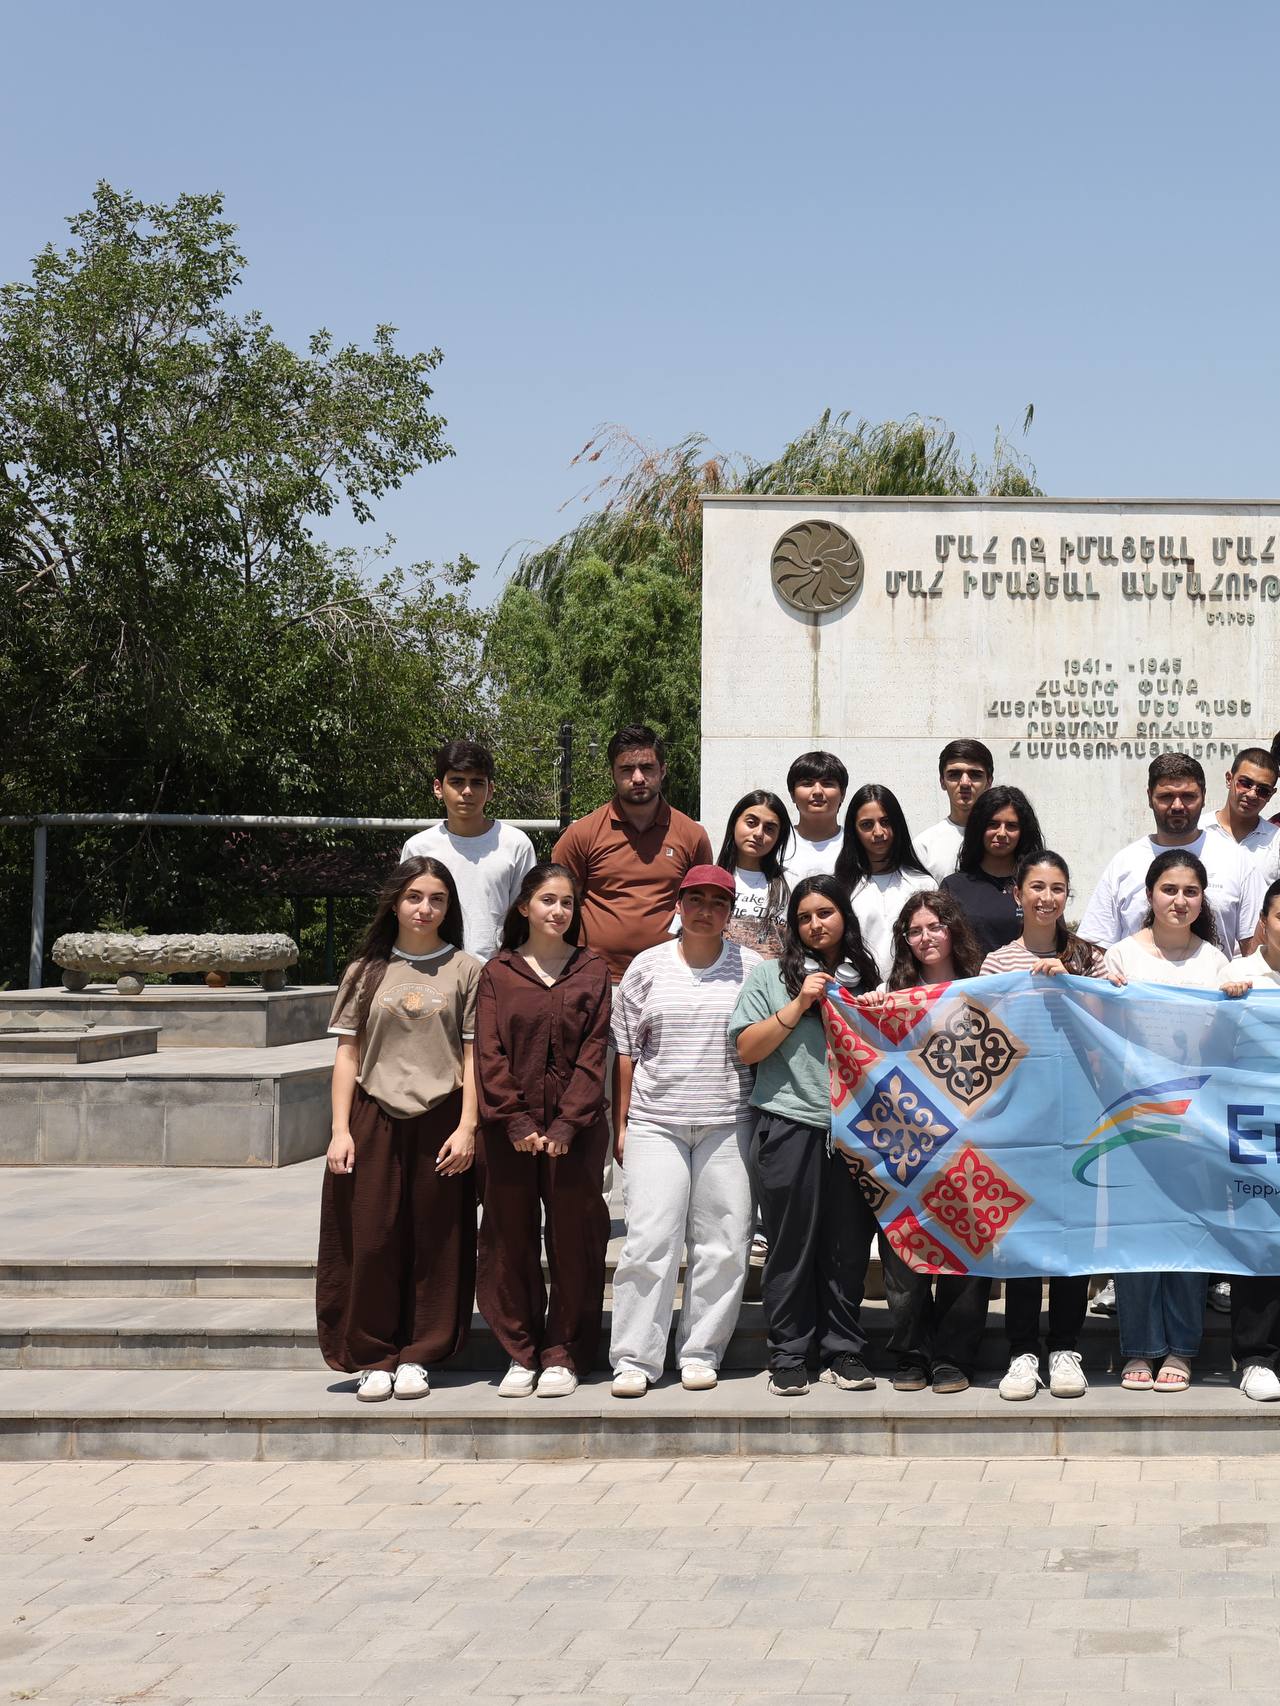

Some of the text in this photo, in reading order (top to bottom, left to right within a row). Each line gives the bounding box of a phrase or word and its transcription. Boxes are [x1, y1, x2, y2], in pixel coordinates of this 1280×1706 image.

[935, 534, 999, 563] ՄԱՀ
[1011, 535, 1047, 564] ՈՉ
[1059, 535, 1195, 565] ԻՄԱՑԵԱԼ
[1212, 535, 1276, 565] ՄԱՀ
[885, 570, 945, 599] ՄԱՀ
[963, 570, 1101, 600] ԻՄԱՑԵԱԼ
[1035, 679, 1119, 698] ՀԱՎԵՐԺ
[987, 699, 1119, 718] ՀԱՅՐԵՆԱԿԱՆ
[1138, 699, 1179, 717] ՄԵԾ
[731, 905, 749, 919] he
